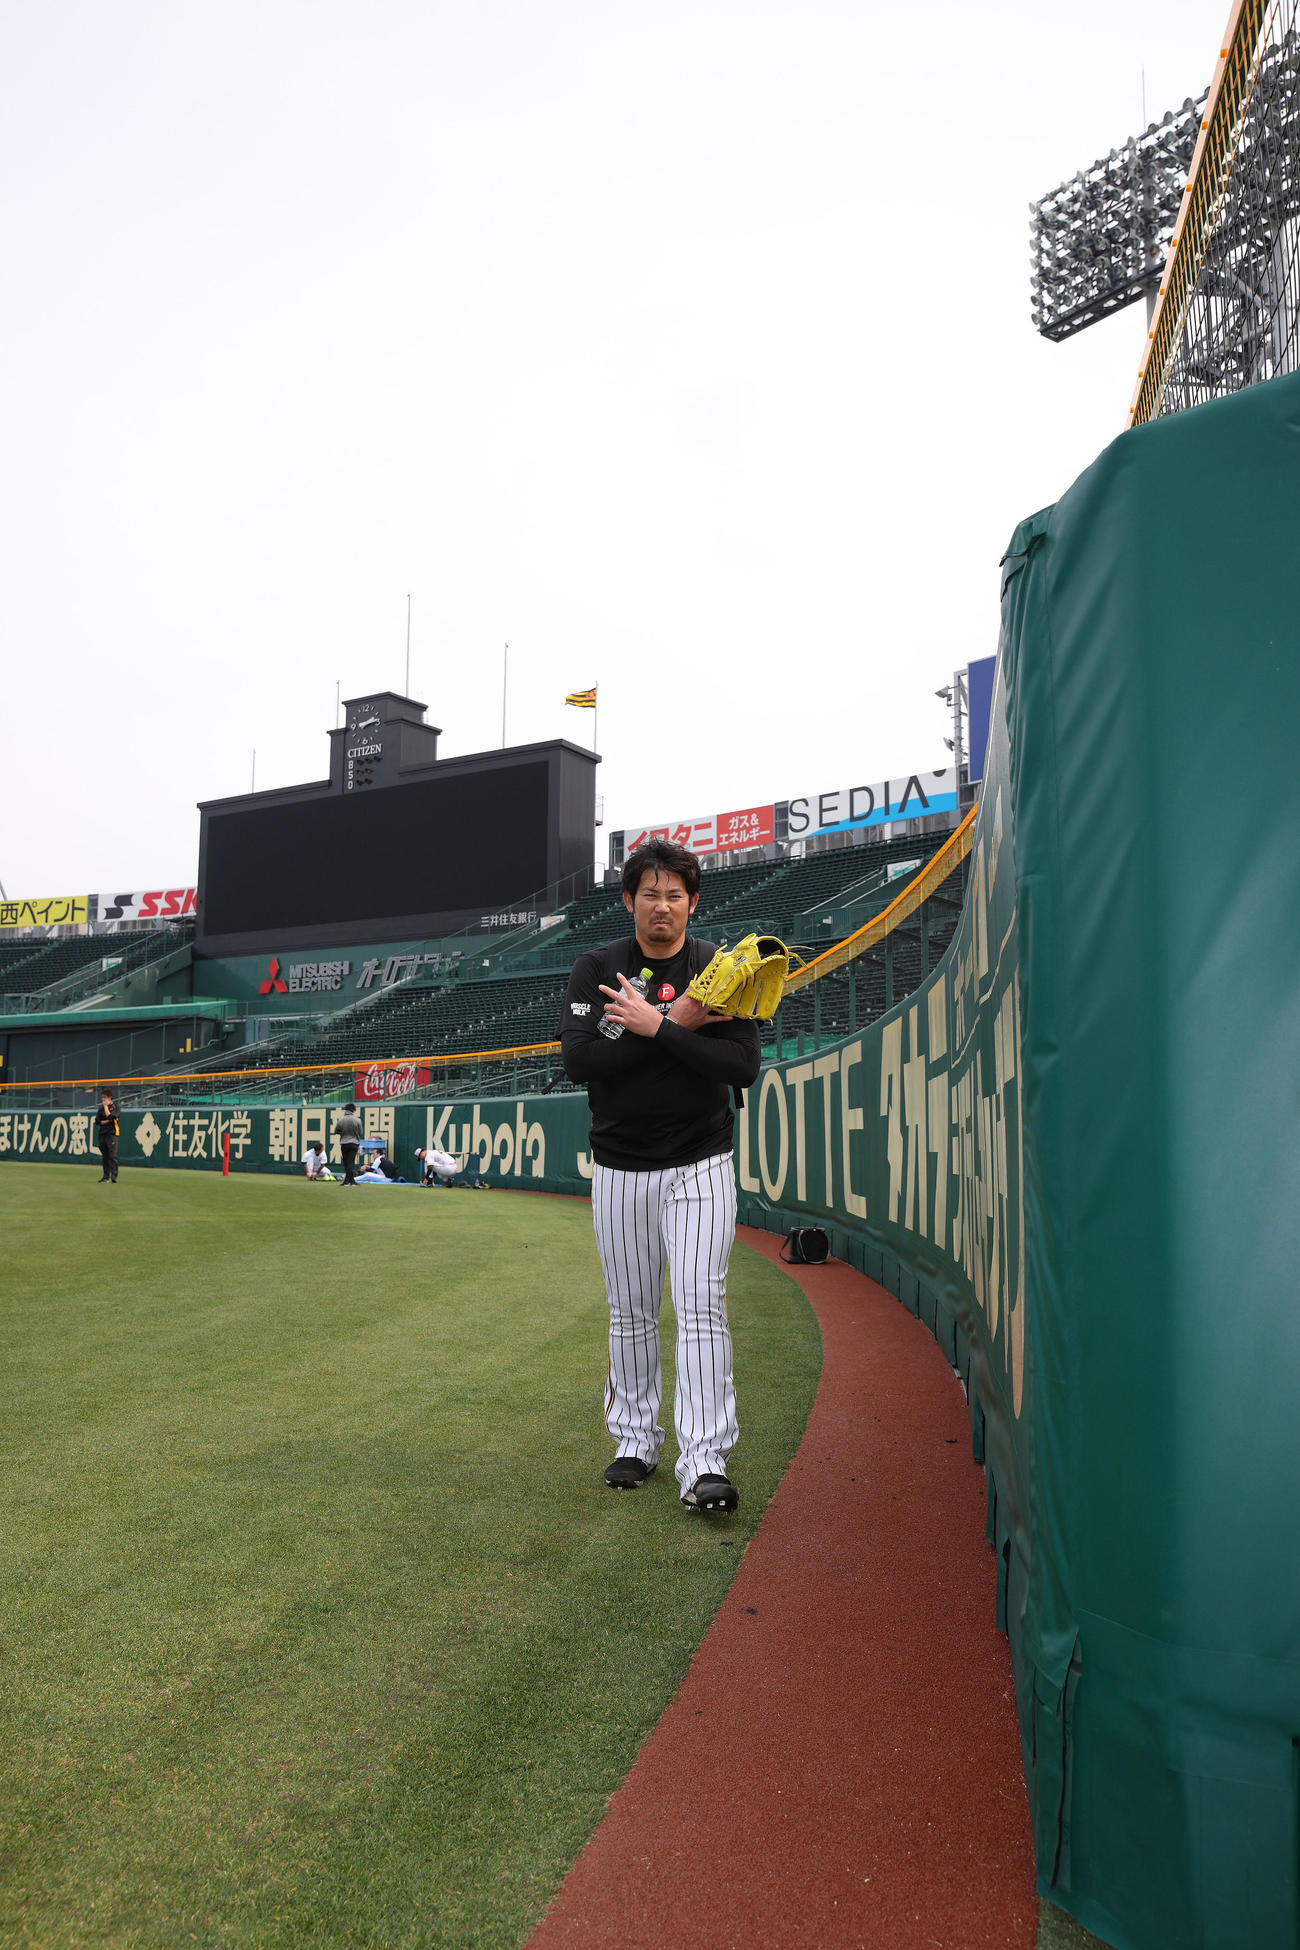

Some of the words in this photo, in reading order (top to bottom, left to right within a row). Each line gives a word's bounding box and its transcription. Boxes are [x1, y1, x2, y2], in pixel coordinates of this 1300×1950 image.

[347, 744, 382, 758] CITIZEN
[348, 760, 354, 769] B
[719, 829, 771, 846] エネルギー
[0, 898, 86, 926] 西ペイント
[480, 911, 537, 928] 三井住友銀行
[289, 960, 350, 978] MITSUBISHI
[289, 976, 341, 993] ELECTRIC
[662, 986, 671, 998] F
[166, 1111, 252, 1159] 住友化学
[739, 1039, 867, 1220] LOTTE
[426, 1102, 546, 1178] Kubota
